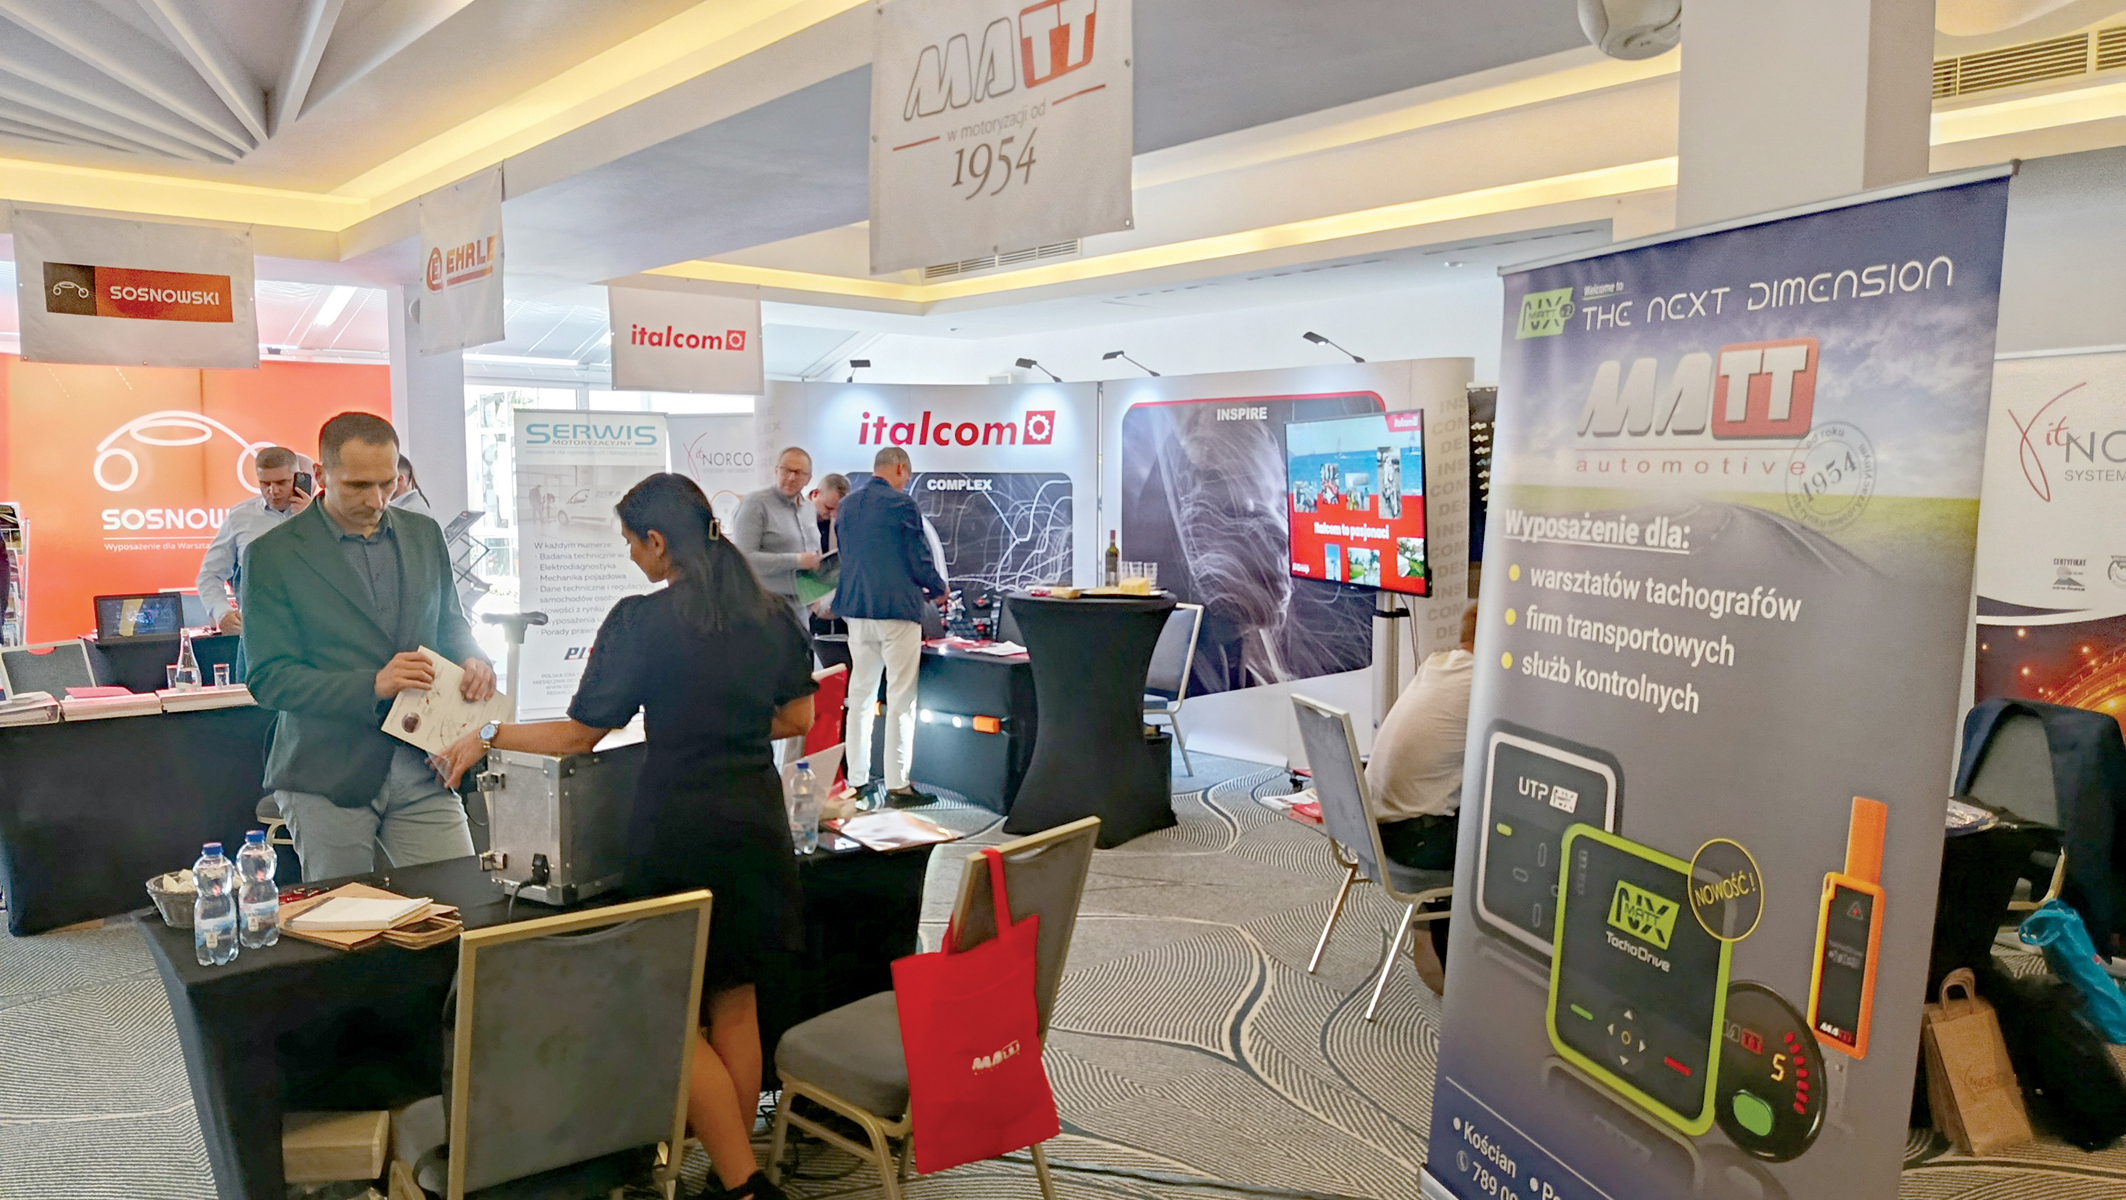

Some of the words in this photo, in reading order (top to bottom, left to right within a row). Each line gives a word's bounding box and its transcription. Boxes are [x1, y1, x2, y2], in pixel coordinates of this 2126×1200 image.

[903, 0, 1097, 121] MATT
[947, 129, 957, 142] w
[961, 107, 1028, 139] motoryzacji
[1031, 98, 1047, 120] od
[951, 127, 1037, 200] 1954
[109, 286, 220, 306] SOSNOWSKI
[1582, 301, 1633, 331] THE
[1647, 286, 1731, 323] NEXT
[1747, 255, 1953, 312] DIMENSION
[1584, 282, 1615, 296] Welcome
[1616, 281, 1624, 292] to
[630, 324, 723, 350] italcom
[1577, 339, 1818, 439] MATT
[1216, 406, 1268, 422] INSPIRE
[526, 423, 657, 446] SERWIS
[858, 411, 1018, 446] italcom
[552, 439, 633, 447] MOTORYZACYJNY
[1576, 457, 1806, 476] automotive
[1803, 450, 1857, 503] 1954
[926, 478, 993, 492] COMPLEX
[101, 508, 230, 531] SOSNOW
[1504, 509, 1640, 545] Wyposażenie
[1645, 515, 1691, 549] dla:
[104, 543, 161, 552] Wyposażenie
[162, 542, 176, 550] dla
[178, 542, 211, 550] Warszta
[544, 542, 576, 550] każdym
[539, 562, 617, 571] Elektrodiagnostyka
[584, 573, 627, 582] pojazdowa
[539, 595, 593, 603] samochodów
[540, 585, 562, 593] Dane
[563, 584, 606, 592] techniczne
[1530, 565, 1641, 600] warsztatów
[1645, 577, 1802, 622] tachografów
[548, 617, 596, 626] yposażenia
[582, 606, 605, 614] rynku
[541, 628, 570, 636] Porady
[1525, 604, 1562, 635] firm
[1566, 613, 1735, 668] transportowych
[1521, 650, 1571, 684] służb
[1574, 659, 1700, 714] kontrolnych
[1518, 776, 1549, 801] UTP
[1605, 930, 1671, 973] TachoDrive
[1770, 1053, 1786, 1082] 5
[1463, 1120, 1517, 1179] Kościan
[1472, 1161, 1498, 1196] 789
